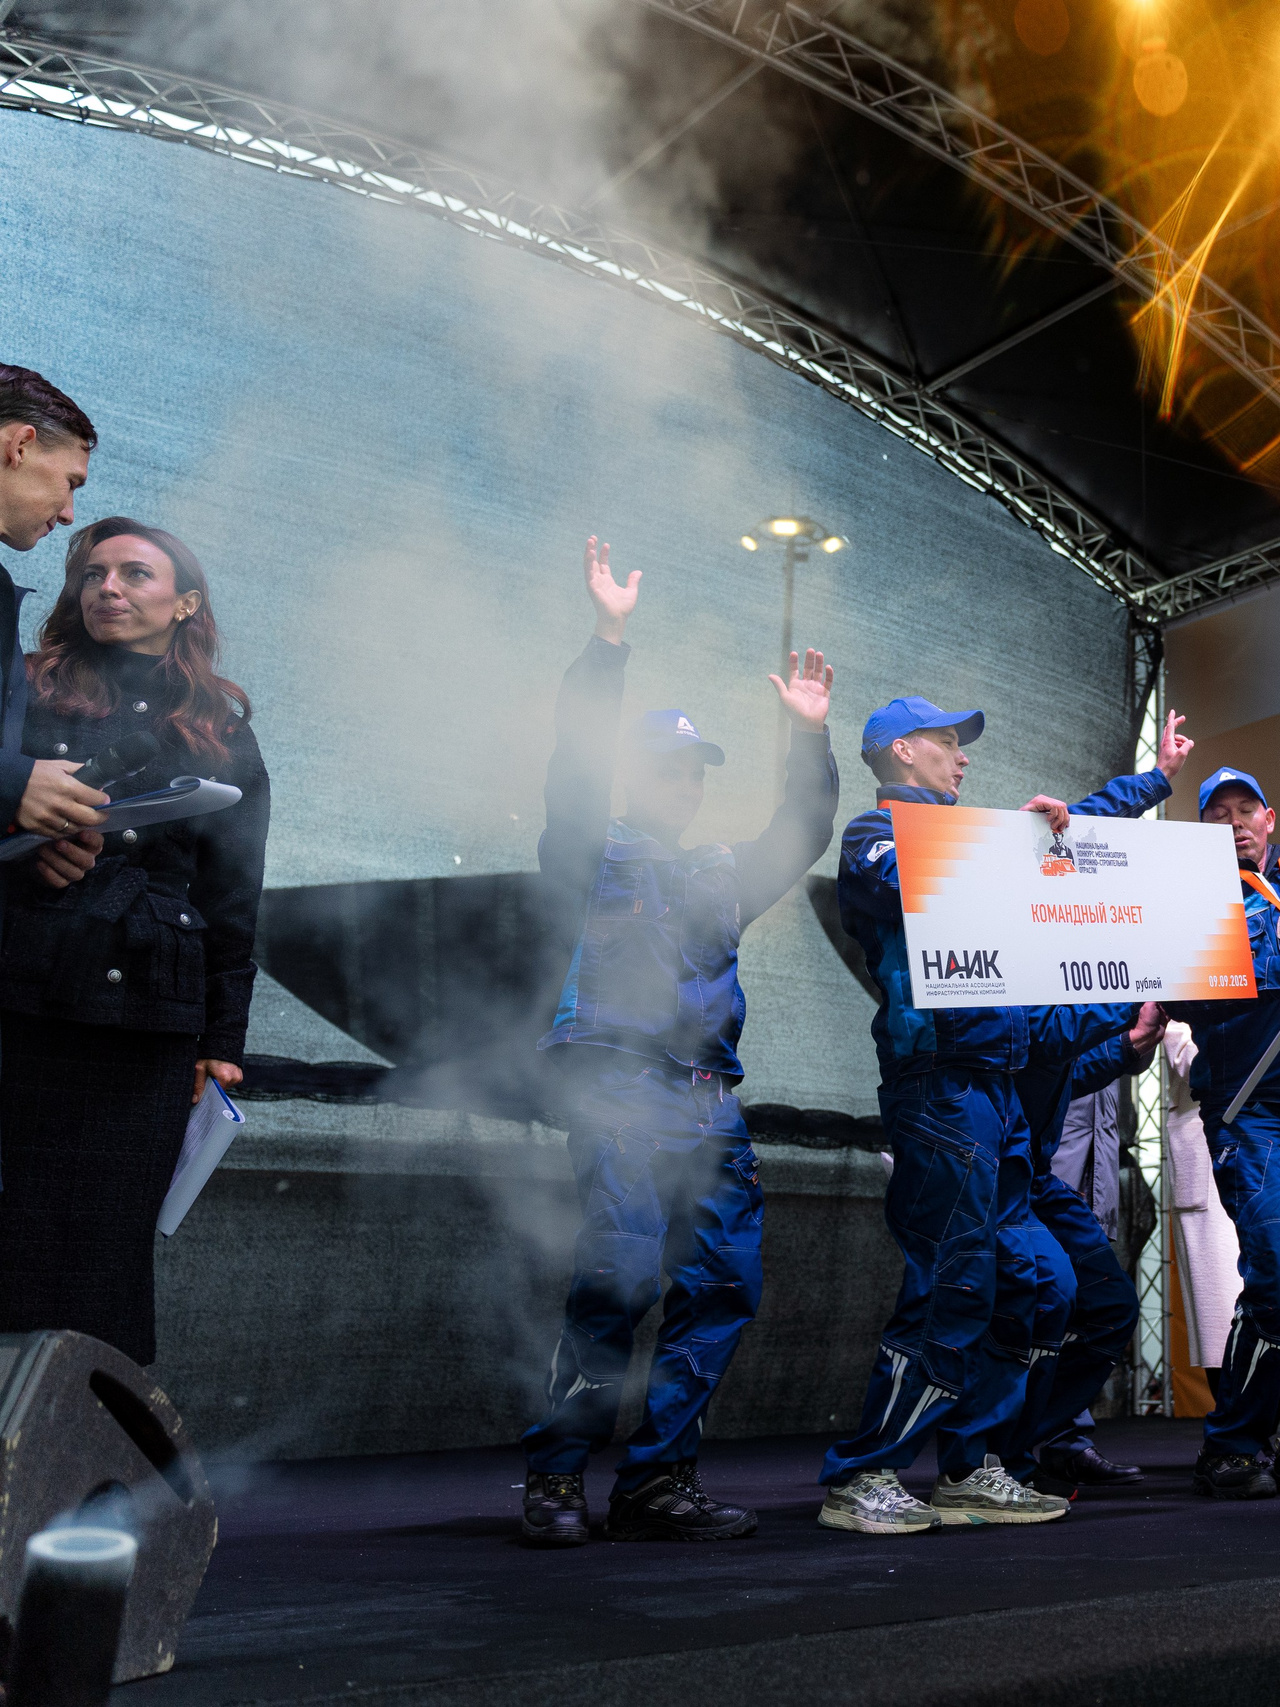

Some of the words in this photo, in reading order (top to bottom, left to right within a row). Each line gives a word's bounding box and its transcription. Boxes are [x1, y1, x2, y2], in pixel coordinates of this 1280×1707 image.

[1076, 842, 1108, 850] НАЦИОНАЛЬНЫЙ
[1095, 851, 1127, 859] МЕХАНИЗАТОРОВ
[1078, 858, 1128, 867] ДОРОЖНО-СТРОИТЕЛЬНОЙ
[1031, 901, 1107, 926] КОМАНДНЫЙ
[1109, 905, 1143, 925] ЗАЧЕТ
[921, 949, 1003, 980] НАИК
[1060, 960, 1092, 992] 100
[1097, 960, 1130, 991] 000
[1135, 976, 1162, 993] рублей
[1208, 975, 1248, 988] 09.09.2025
[926, 989, 979, 997] ИНФРАСТРУКТУРНЫХ
[979, 988, 1006, 996] КОМПАНИЙ
